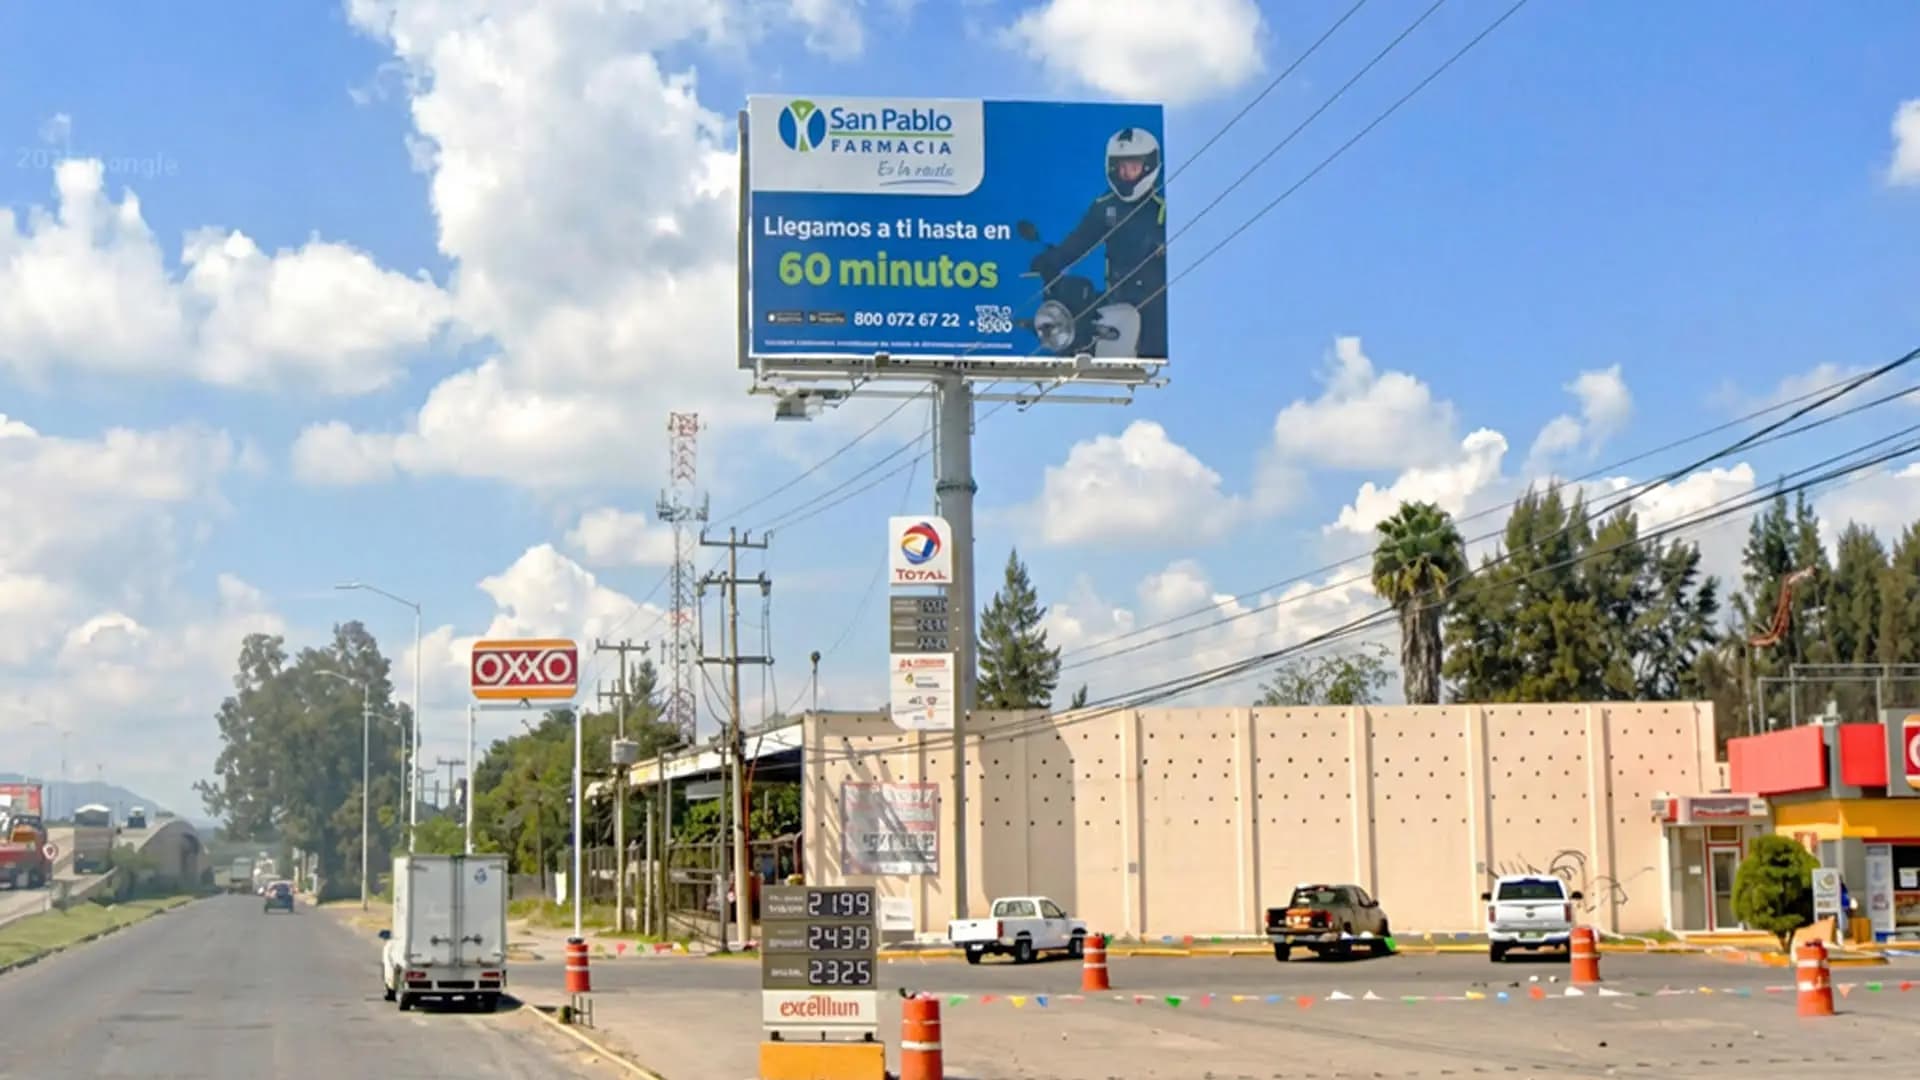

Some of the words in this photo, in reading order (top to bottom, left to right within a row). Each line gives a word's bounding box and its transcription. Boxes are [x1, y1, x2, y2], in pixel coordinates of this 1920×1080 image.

[830, 107, 877, 130] San
[882, 108, 952, 131] Pablo
[831, 139, 952, 154] FARMACIA
[764, 217, 872, 240] Llegamos
[877, 222, 890, 237] a
[896, 219, 912, 239] ti
[918, 219, 977, 239] hasta
[983, 224, 1010, 239] en
[779, 251, 831, 285] 60
[839, 251, 999, 288] minutos
[854, 312, 884, 326] 800
[887, 312, 915, 327] 072
[918, 312, 938, 327] 67
[941, 313, 961, 328] 22
[895, 568, 947, 580] TOTAL
[475, 650, 572, 687] OXXO
[808, 893, 870, 916] 2199
[808, 926, 870, 950] 2439
[808, 960, 871, 984] 2325
